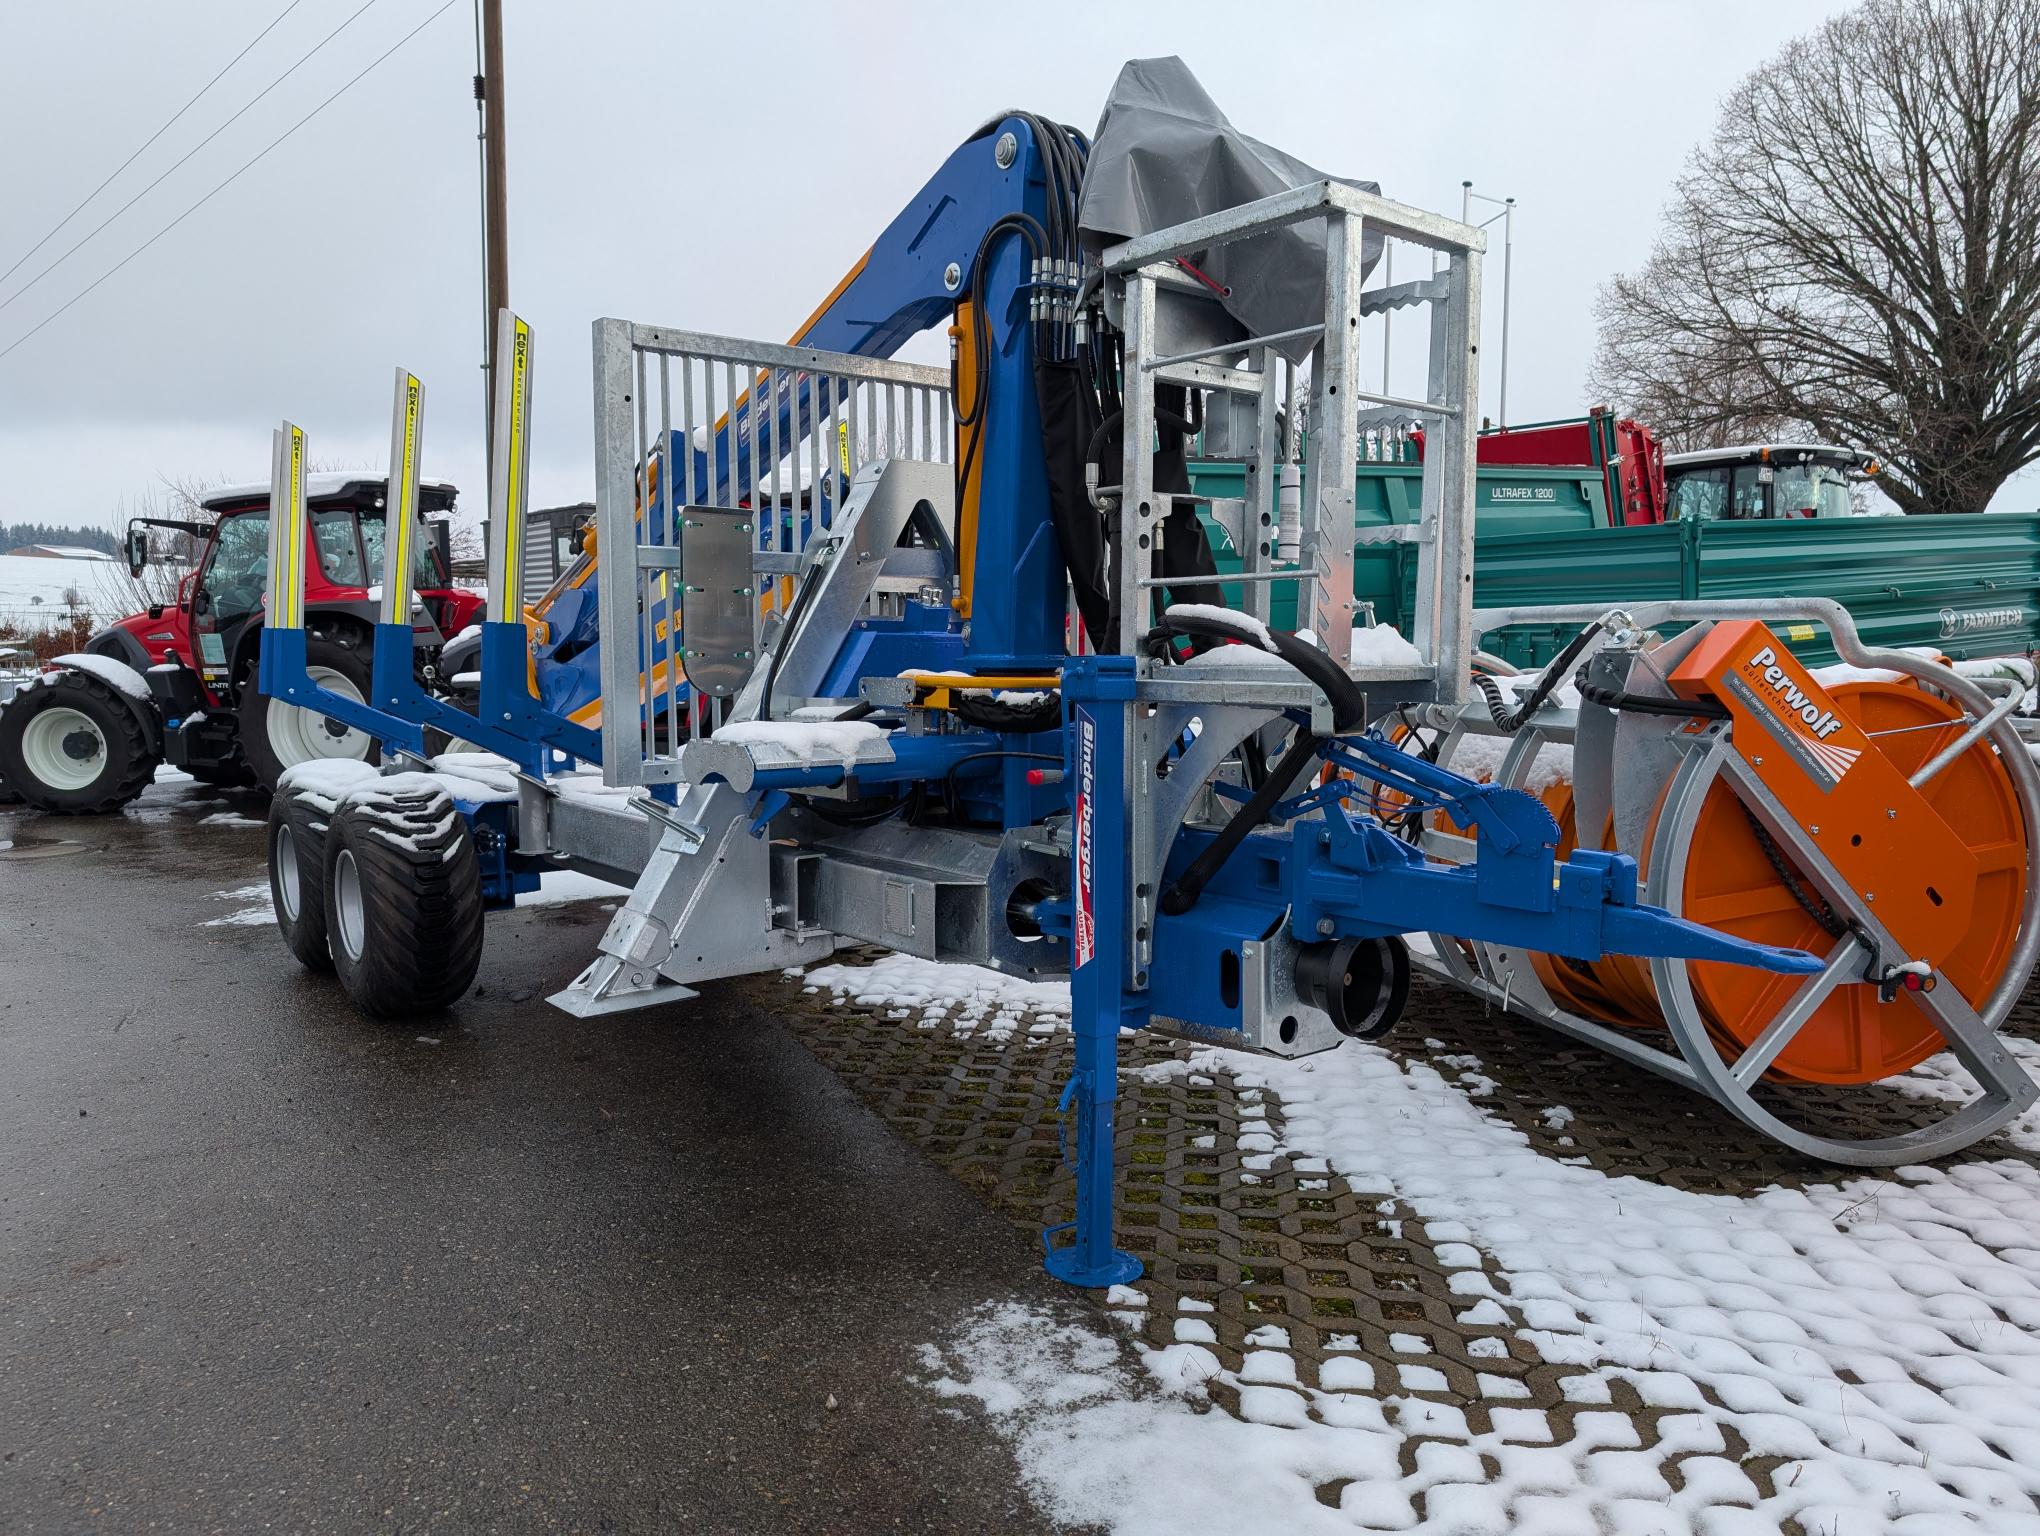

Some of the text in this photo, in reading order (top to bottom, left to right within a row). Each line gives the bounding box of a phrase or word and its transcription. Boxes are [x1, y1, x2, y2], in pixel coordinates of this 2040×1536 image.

[516, 332, 526, 369] next
[408, 386, 418, 416] next
[1492, 487, 1554, 499] ULTRAFEX 1200
[1961, 609, 2023, 632] FARMTECH
[1743, 664, 1794, 719] Gülletechnik
[1750, 645, 1843, 740] Perwolf
[1082, 720, 1094, 894] Binderberger
